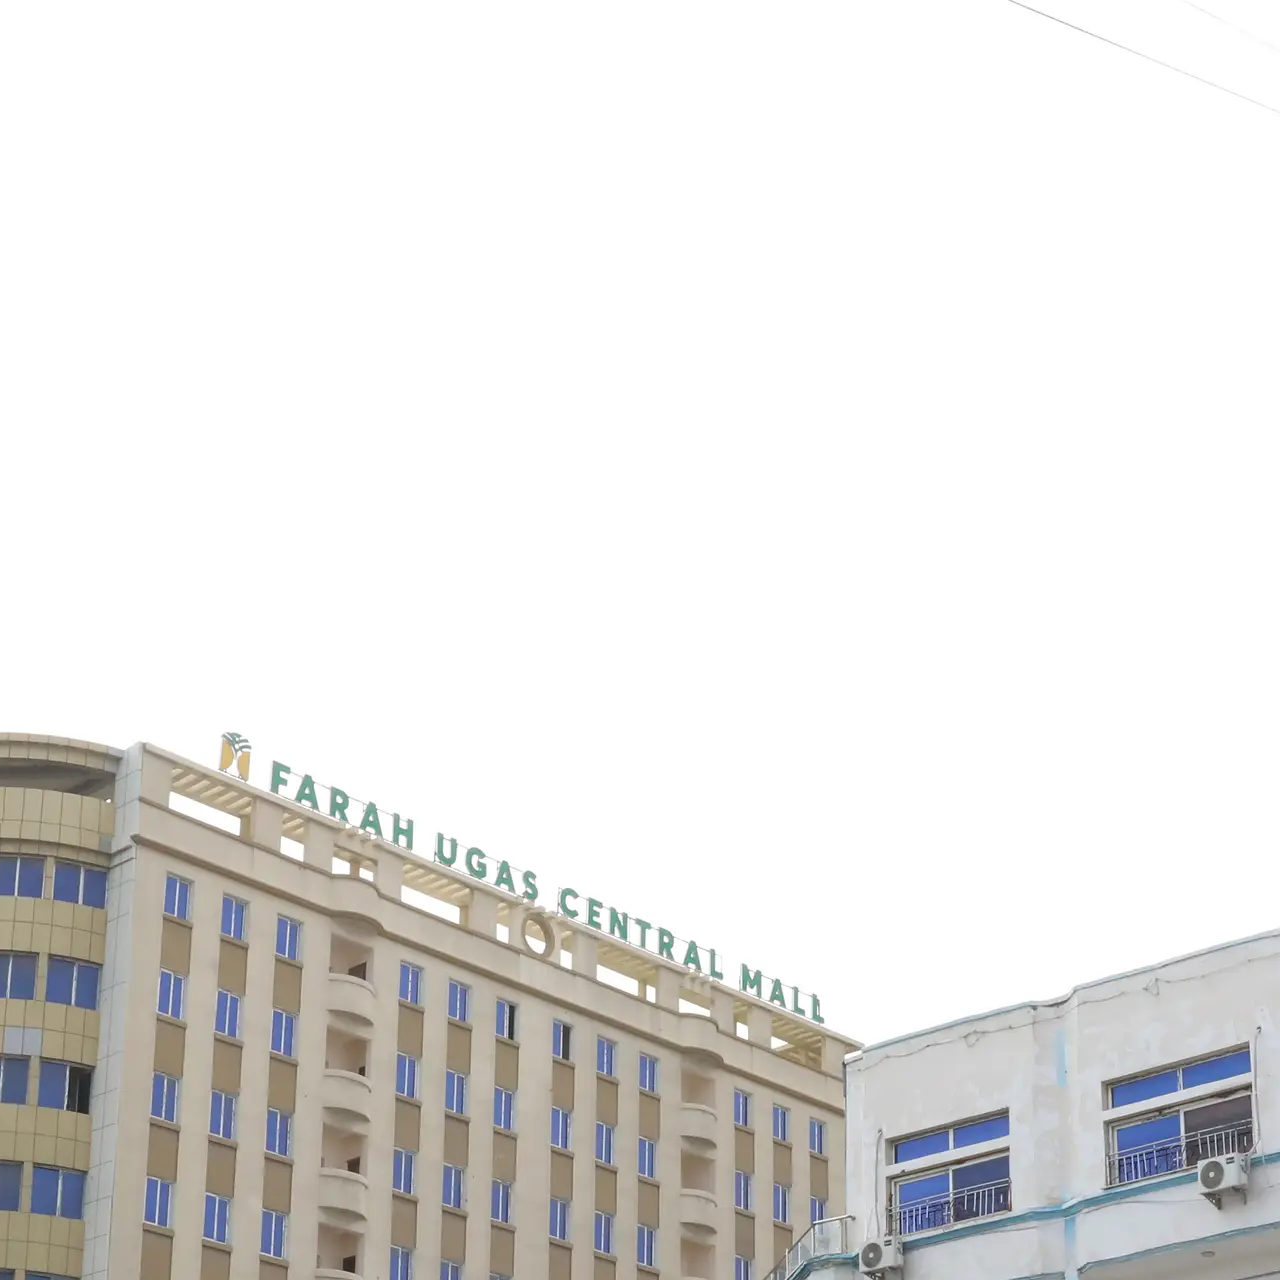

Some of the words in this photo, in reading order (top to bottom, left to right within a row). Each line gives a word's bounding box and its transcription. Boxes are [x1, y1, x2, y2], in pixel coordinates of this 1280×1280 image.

[271, 761, 414, 851] FARAH
[436, 833, 538, 900] UGAS
[559, 888, 723, 980] CENTRAL
[740, 964, 824, 1024] MALL
